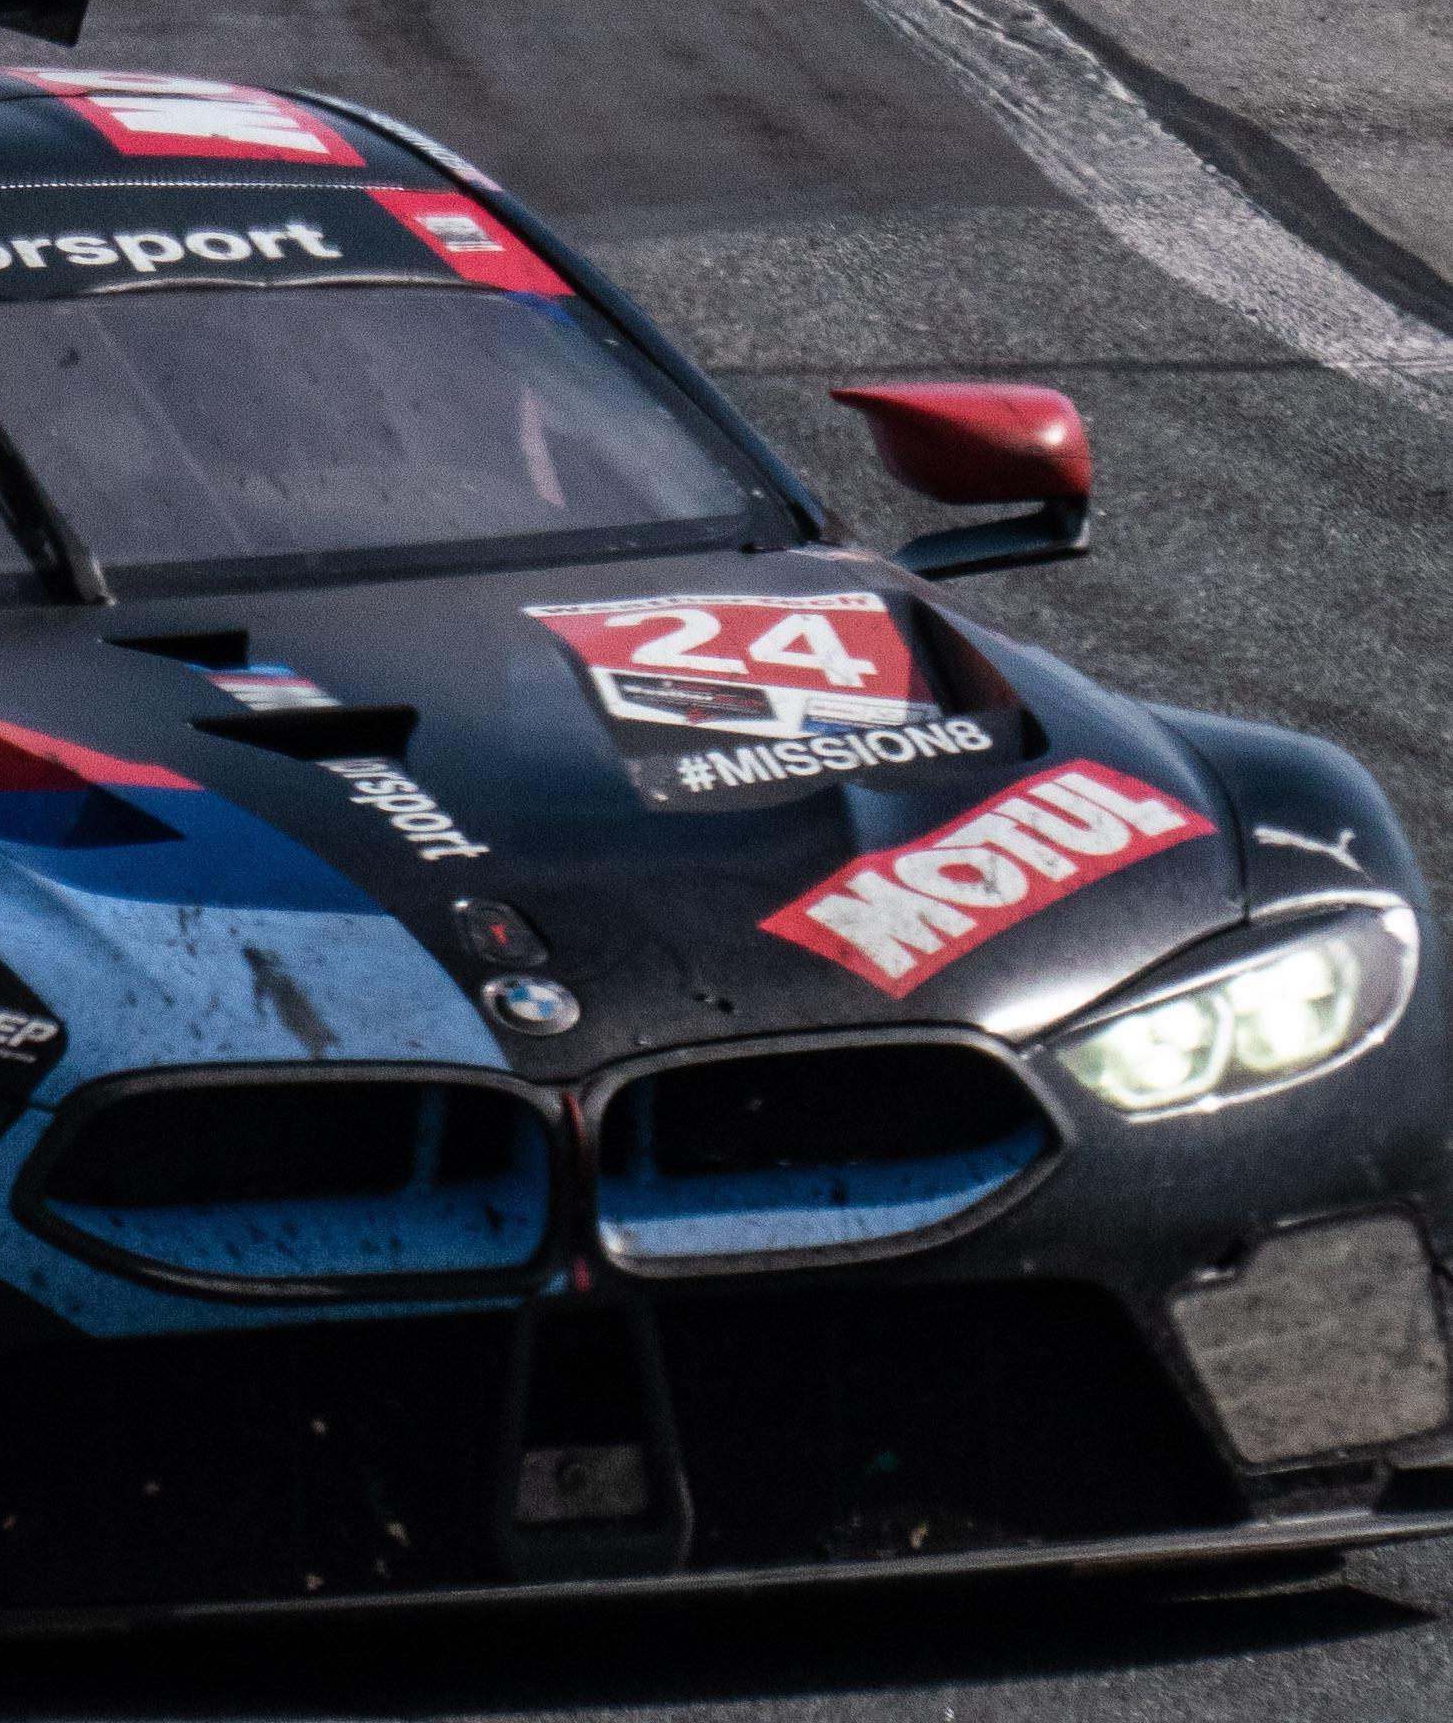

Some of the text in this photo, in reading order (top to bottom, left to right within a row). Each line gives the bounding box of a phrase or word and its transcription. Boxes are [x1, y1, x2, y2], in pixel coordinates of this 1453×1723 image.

[604, 607, 880, 689] 24
[675, 718, 995, 794] #MISSION8
[806, 770, 1188, 983] MOTUL
